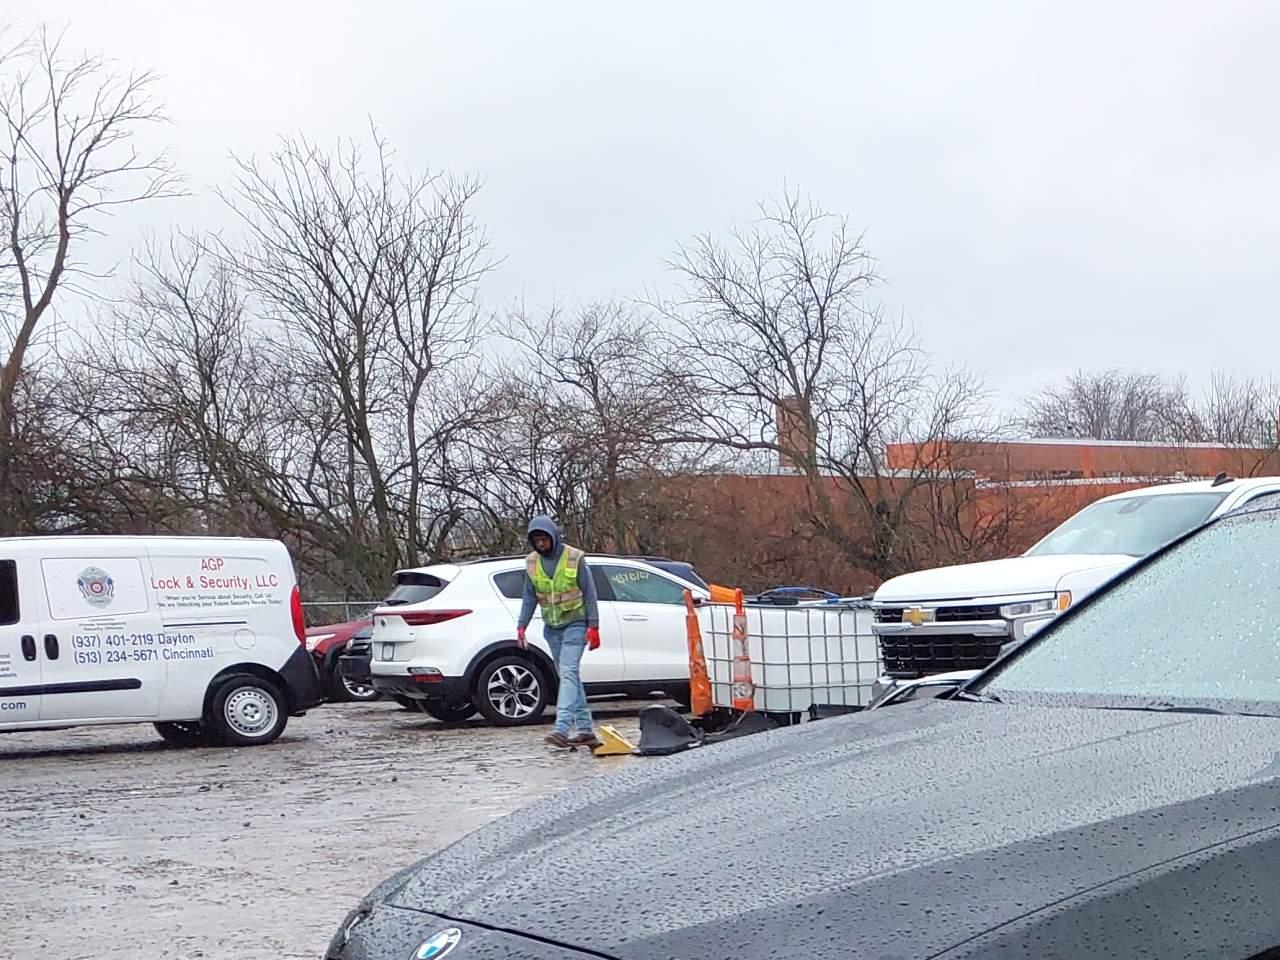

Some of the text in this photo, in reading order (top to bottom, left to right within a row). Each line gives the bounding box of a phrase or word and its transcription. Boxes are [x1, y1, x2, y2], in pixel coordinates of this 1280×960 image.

[201, 558, 224, 571] AGP
[150, 574, 278, 590] Lock & Security, LLC
[72, 633, 195, 649] (937) 401-2119 Dayton
[74, 647, 214, 664] (513) 234-5671 Cincinnati
